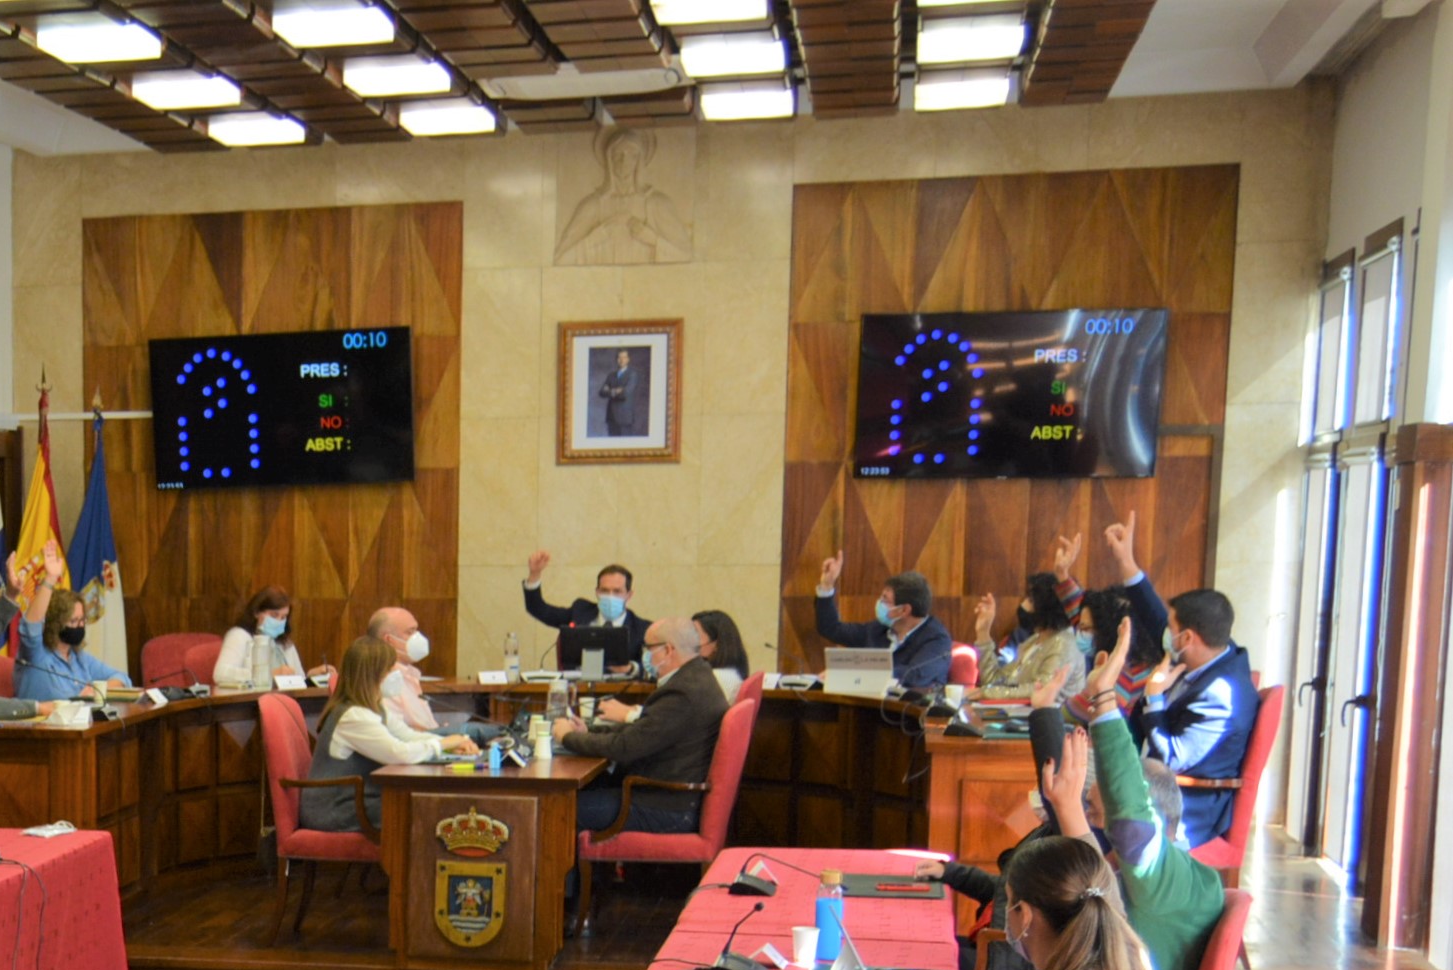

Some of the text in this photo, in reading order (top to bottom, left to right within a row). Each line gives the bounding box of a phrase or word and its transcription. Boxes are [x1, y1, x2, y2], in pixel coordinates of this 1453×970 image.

[1085, 317, 1135, 335] 00:10
[342, 330, 388, 350] 00:10
[1050, 403, 1075, 417] NO
